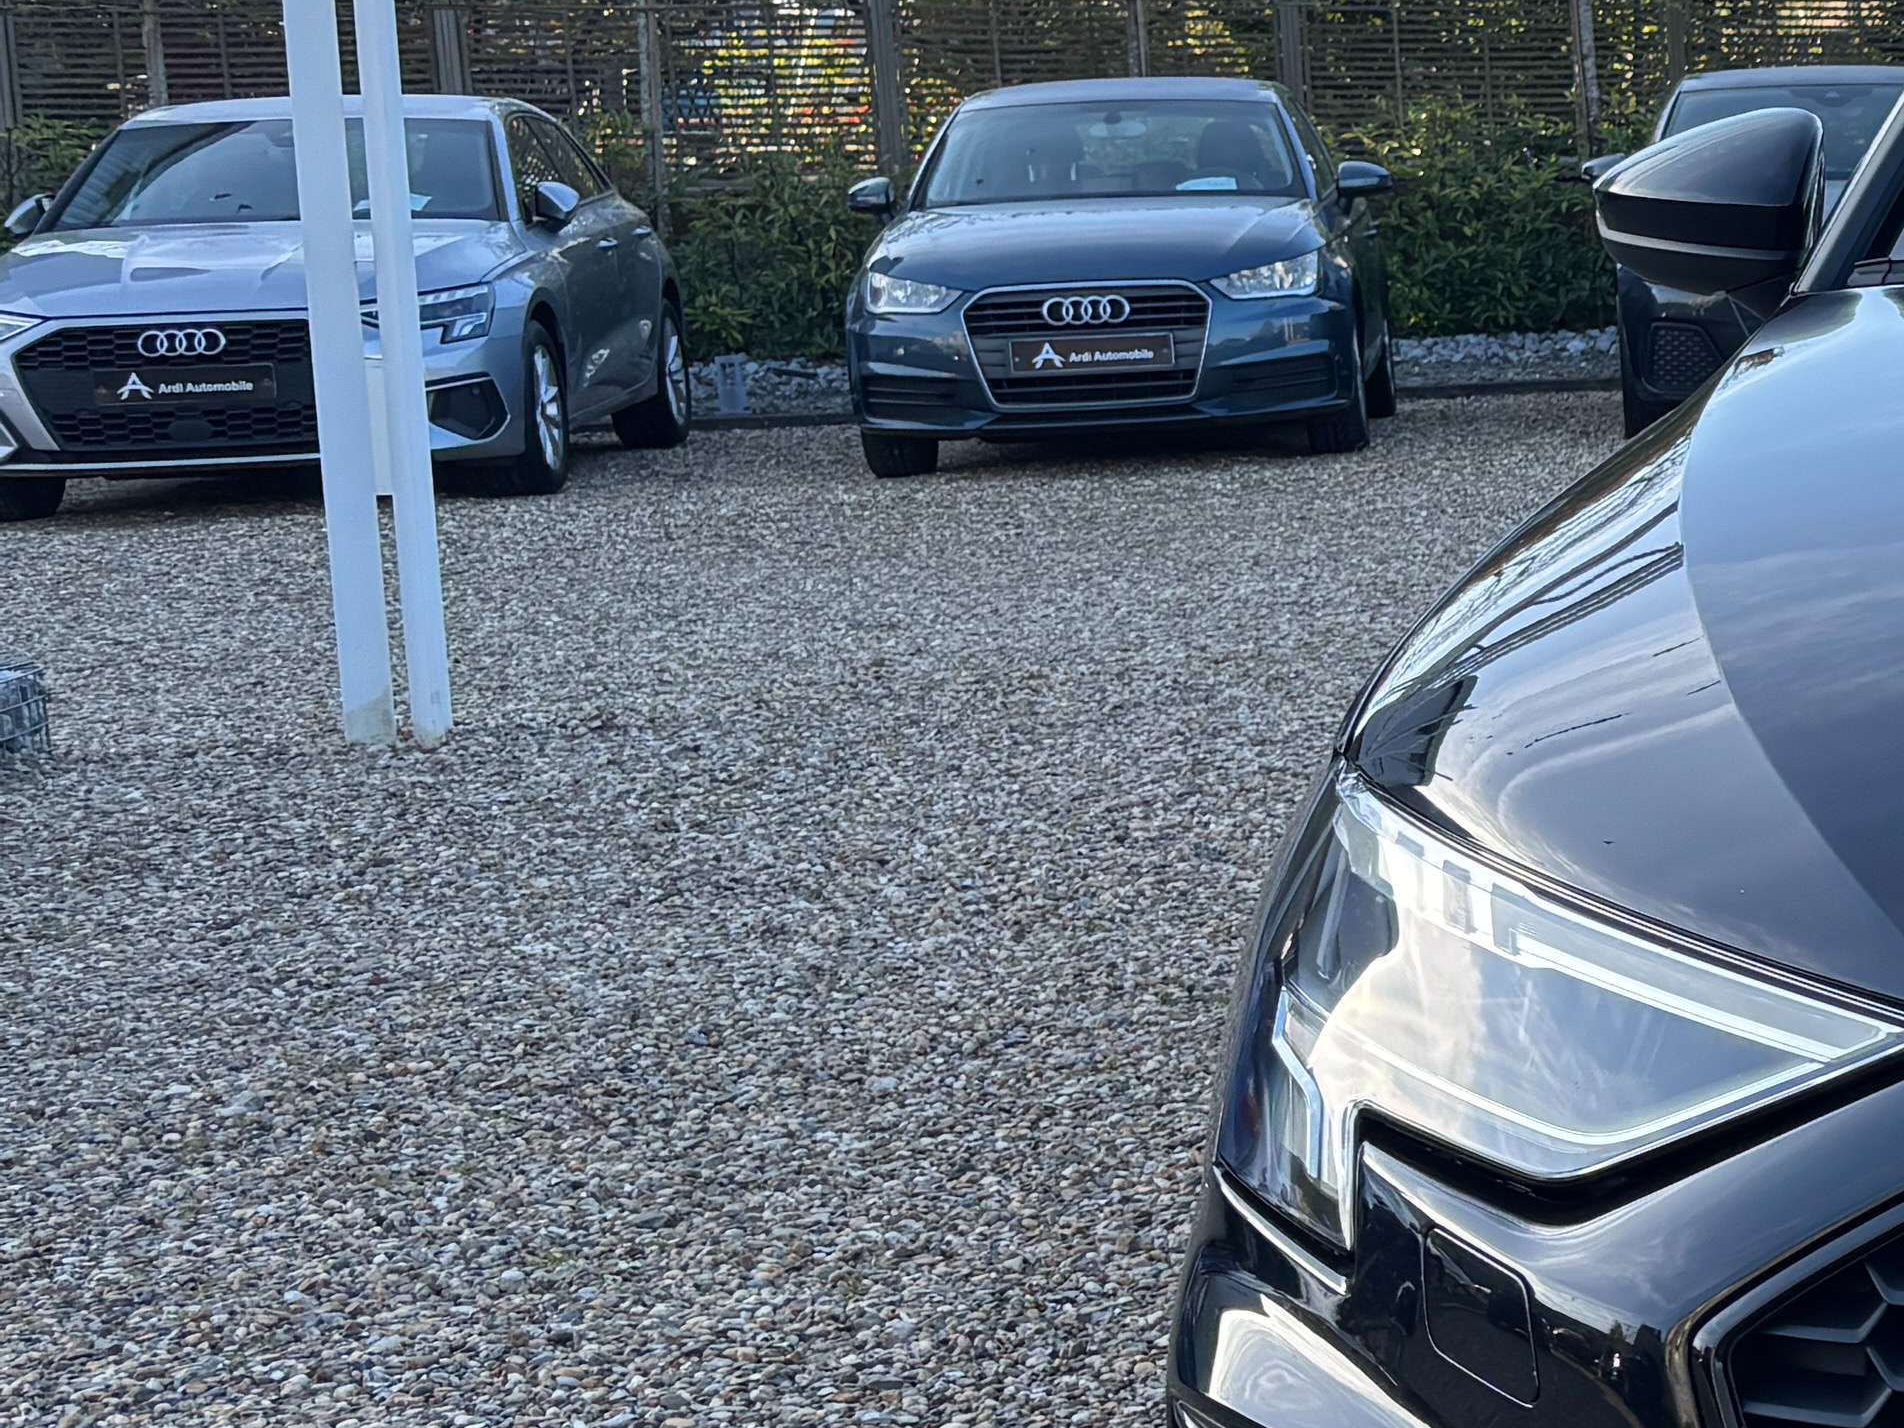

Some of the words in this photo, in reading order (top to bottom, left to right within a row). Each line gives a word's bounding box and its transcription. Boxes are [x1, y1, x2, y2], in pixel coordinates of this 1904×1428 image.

[1069, 351, 1092, 363] Ardi
[1093, 348, 1154, 362] Automobile
[158, 382, 184, 395] Ardi
[185, 380, 254, 394] Automobile
